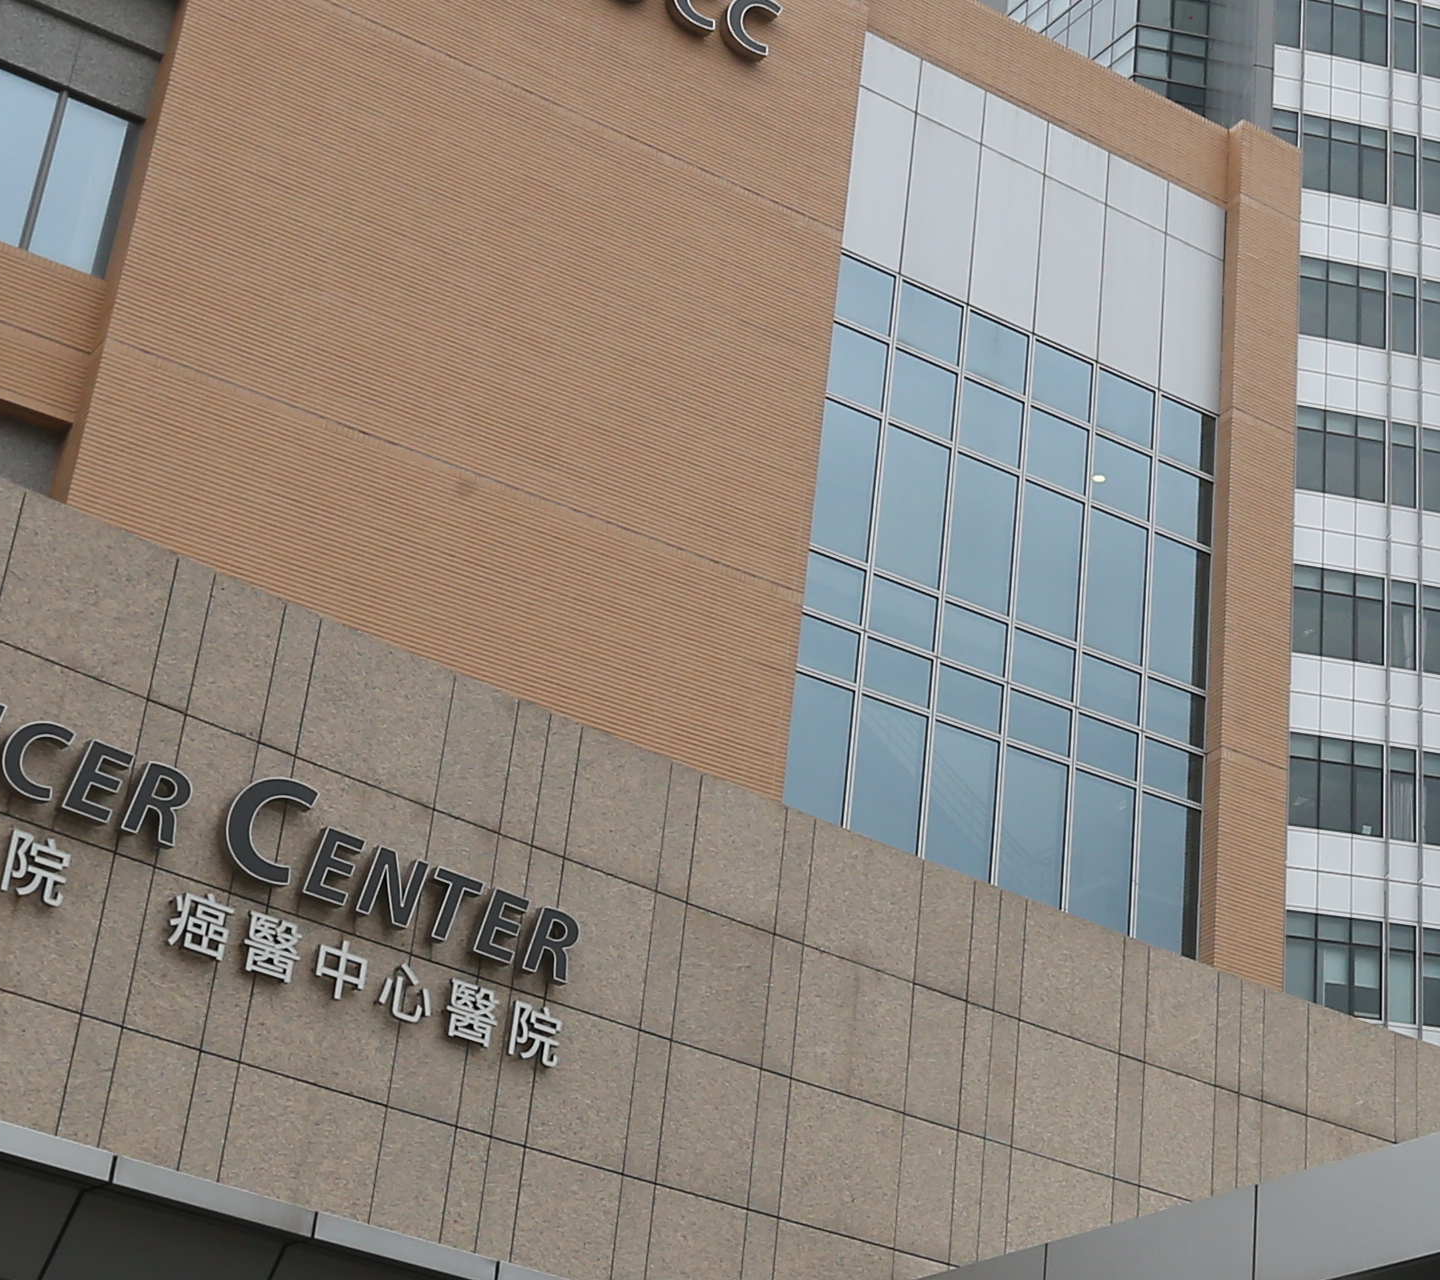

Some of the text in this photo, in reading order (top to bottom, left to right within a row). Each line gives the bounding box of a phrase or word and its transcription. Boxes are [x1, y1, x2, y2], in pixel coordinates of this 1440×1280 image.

[224, 777, 580, 984] CENTER
[166, 890, 563, 1069] 癌醫中心醫院
